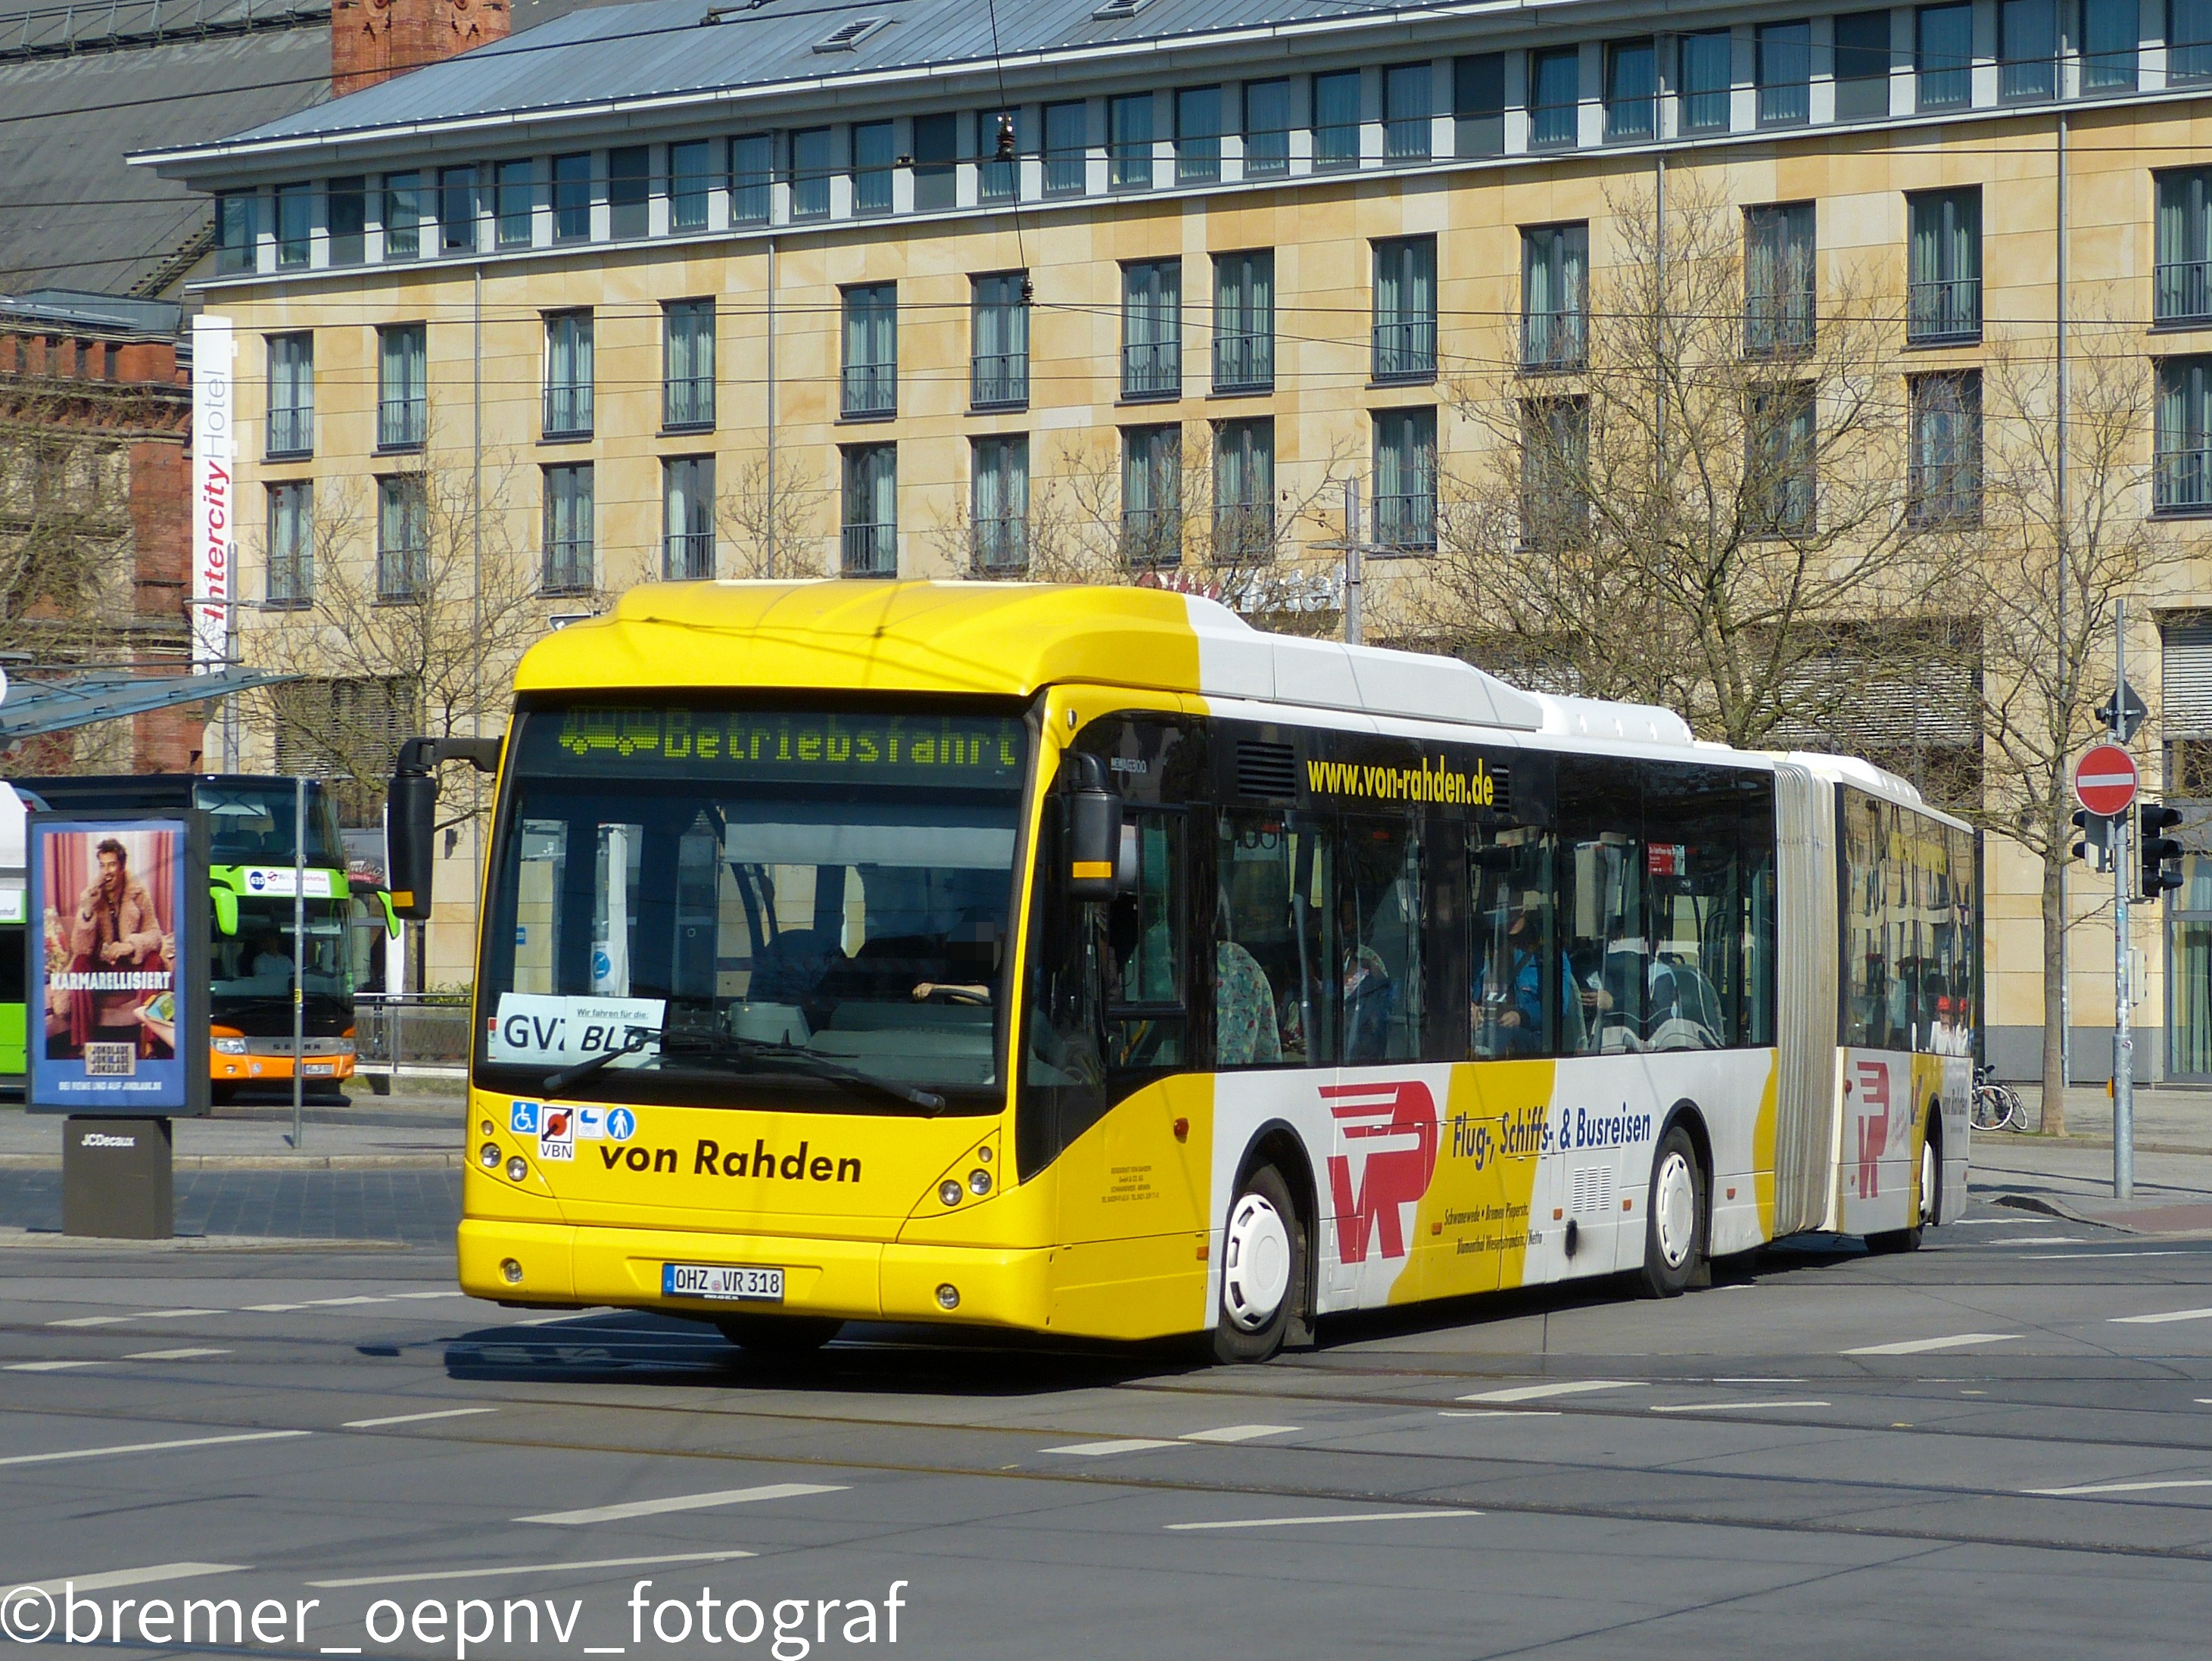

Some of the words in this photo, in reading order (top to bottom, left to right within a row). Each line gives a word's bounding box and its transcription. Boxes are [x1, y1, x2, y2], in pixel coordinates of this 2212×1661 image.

[664, 707, 1016, 765] Betriebsfahrt
[1307, 755, 1494, 806] www.von-rahden.de
[50, 971, 171, 989] KARMARELLISIERT
[577, 1008, 590, 1017] Wir
[593, 1009, 619, 1018] fahren
[620, 1010, 632, 1018] für
[81, 1134, 135, 1146] JCDecaux
[1453, 1111, 1494, 1171] Flug-,
[1500, 1106, 1553, 1154] Schiffs-
[1559, 1108, 1571, 1150] &
[1576, 1102, 1650, 1148] Busreisen
[541, 1144, 573, 1159] VBN
[600, 1145, 678, 1173] von
[694, 1139, 861, 1183] Rahden
[676, 1270, 709, 1290] OHZ
[722, 1271, 743, 1292] VR
[748, 1273, 780, 1293] 318
